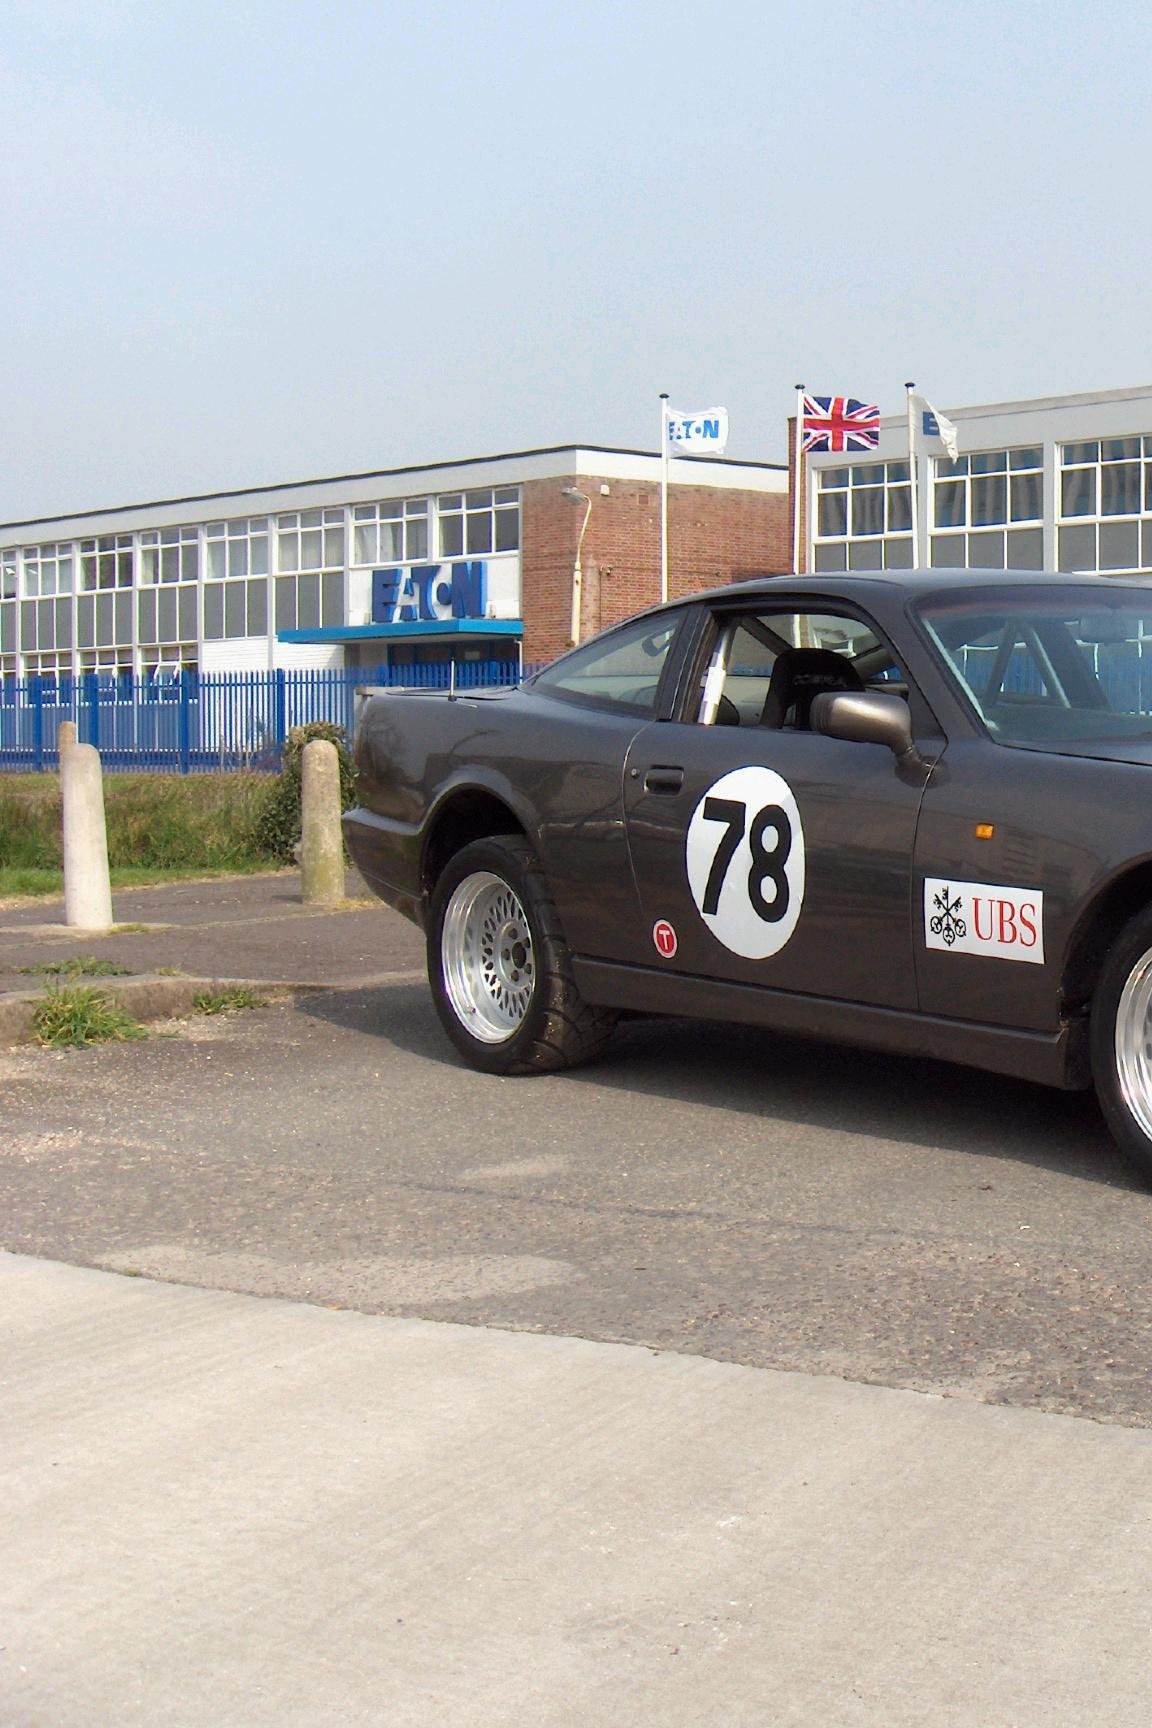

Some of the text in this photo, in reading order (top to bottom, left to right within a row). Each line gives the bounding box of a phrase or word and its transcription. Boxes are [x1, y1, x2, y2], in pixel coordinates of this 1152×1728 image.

[668, 419, 720, 441] EATON
[372, 561, 488, 623] EATON
[702, 796, 792, 924] 78
[659, 929, 671, 950] T
[972, 896, 1037, 947] UBS
